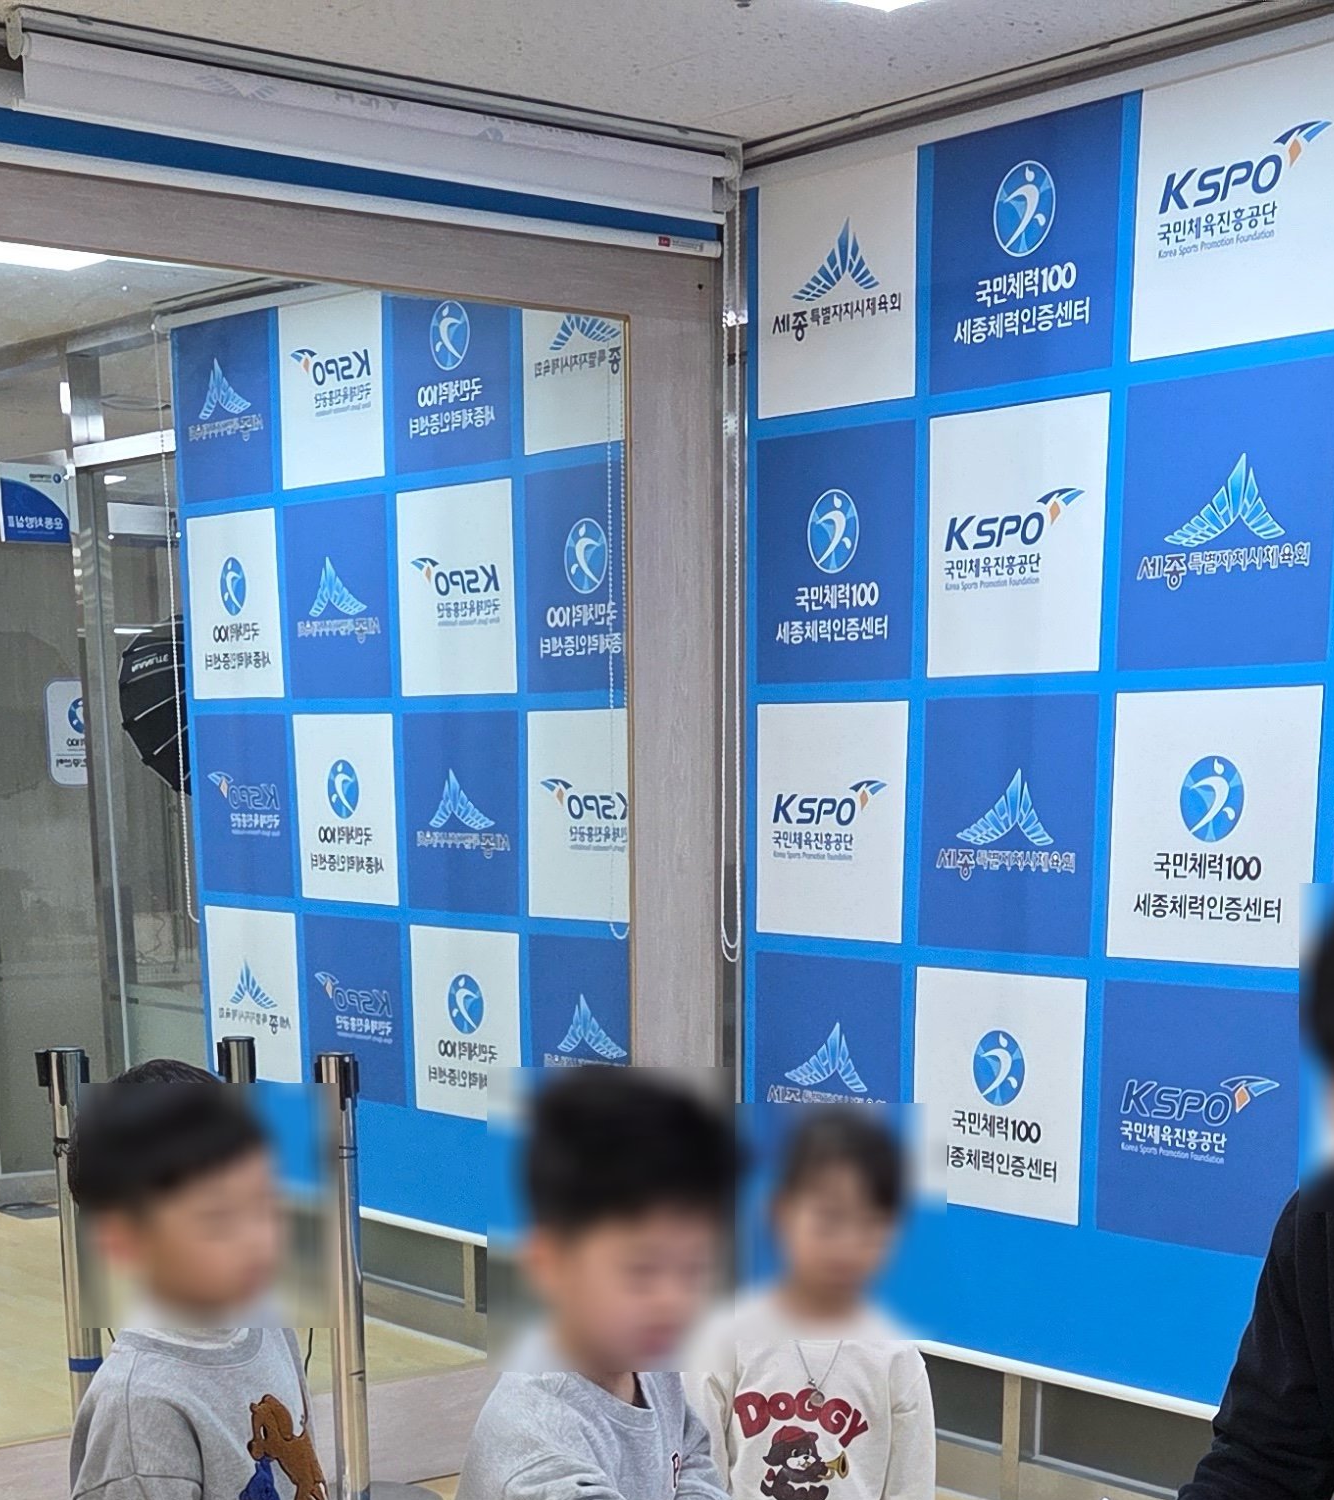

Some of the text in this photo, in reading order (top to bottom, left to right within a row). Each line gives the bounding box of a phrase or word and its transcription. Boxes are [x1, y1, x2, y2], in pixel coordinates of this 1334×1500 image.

[1158, 154, 1283, 214] KSPO
[1157, 201, 1278, 245] 국민체육진흥공단
[975, 262, 1077, 308] 국민체력100
[953, 297, 1091, 345] 세종체력인증센터
[944, 512, 1044, 552] KSPO
[944, 553, 1041, 580] 국민체육진흥공단
[795, 582, 879, 612] 국민체력100
[776, 615, 889, 645] 세종체력인증센터
[772, 793, 856, 826] KSPO
[772, 831, 854, 853] 국민체육진흥공단
[1152, 851, 1262, 882] 국민체력100
[1133, 893, 1282, 924] 세종체력인증센터
[1120, 1079, 1232, 1127] KSPO
[950, 1110, 1041, 1144] 국민체력100
[1120, 1120, 1227, 1154] 국민체육진흥공단
[946, 1144, 1058, 1184] 종체력인증센터
[733, 1387, 869, 1449] DOGGY
